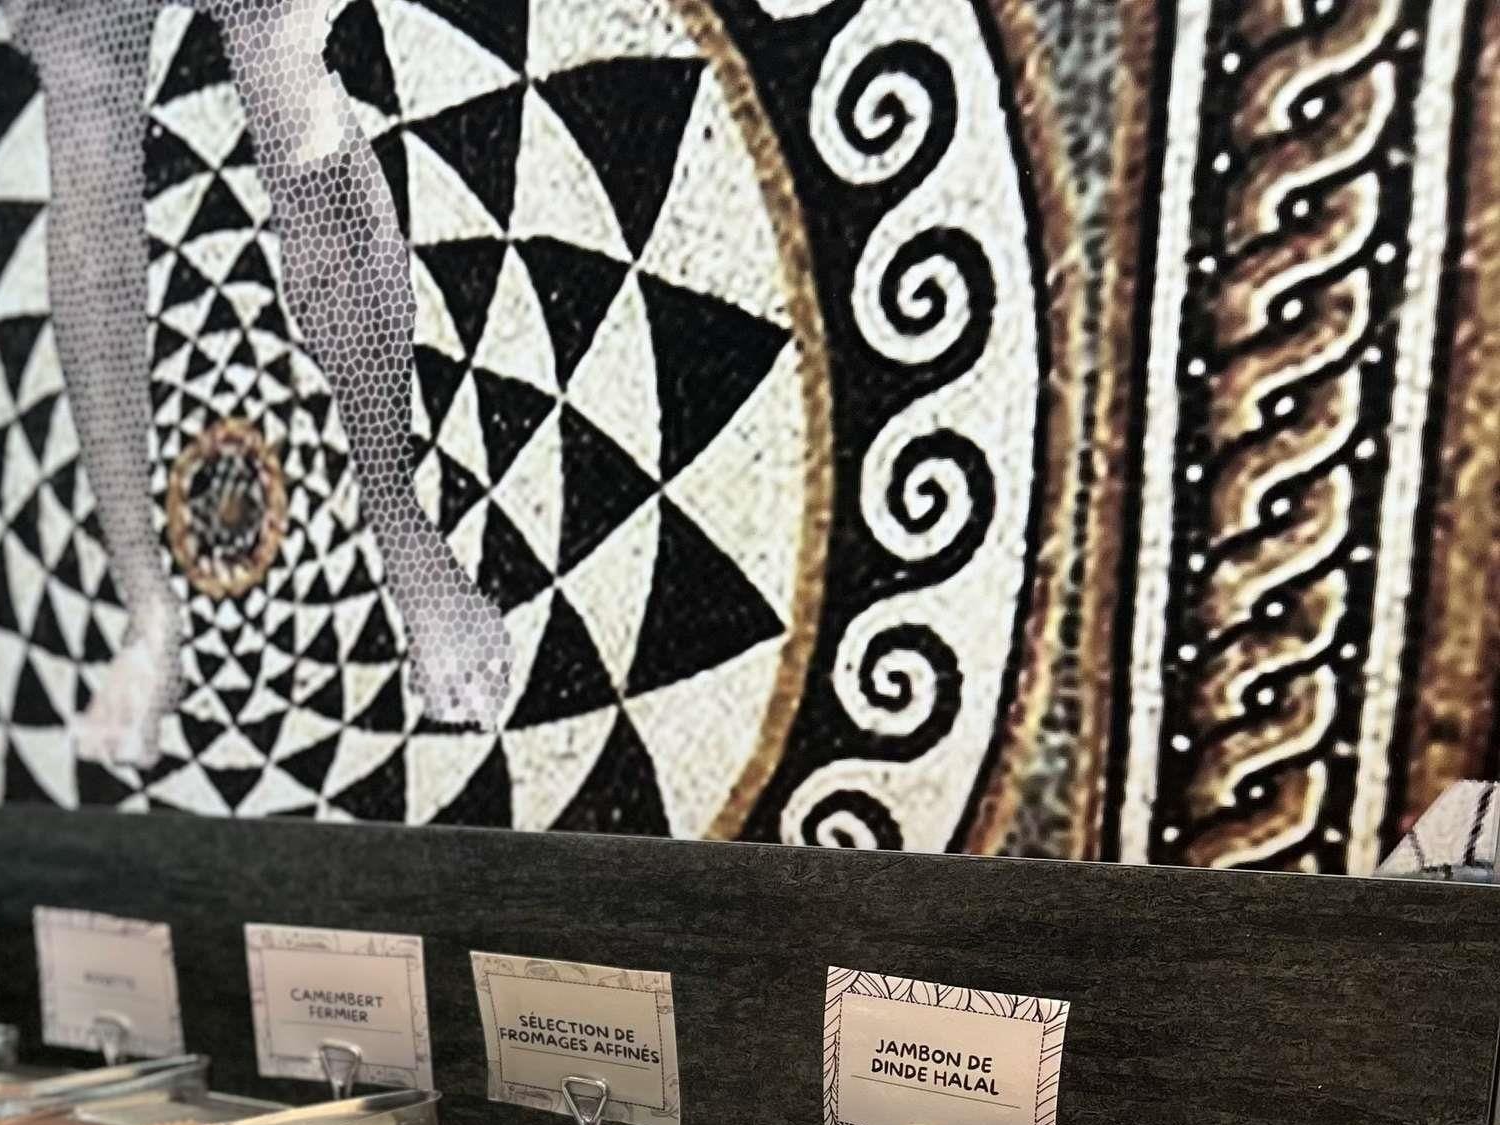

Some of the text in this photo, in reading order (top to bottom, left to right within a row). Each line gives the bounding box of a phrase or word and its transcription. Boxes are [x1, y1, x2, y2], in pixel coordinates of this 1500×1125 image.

[290, 988, 384, 1008] CAMEMBERT
[308, 1004, 368, 1022] FERMIER
[519, 1011, 635, 1043] SÉLECTION DE
[500, 1028, 660, 1064] FROMAGES AFFINÉS
[876, 1039, 992, 1073] JAMBON DE
[872, 1058, 1000, 1096] DINDE HALAL
